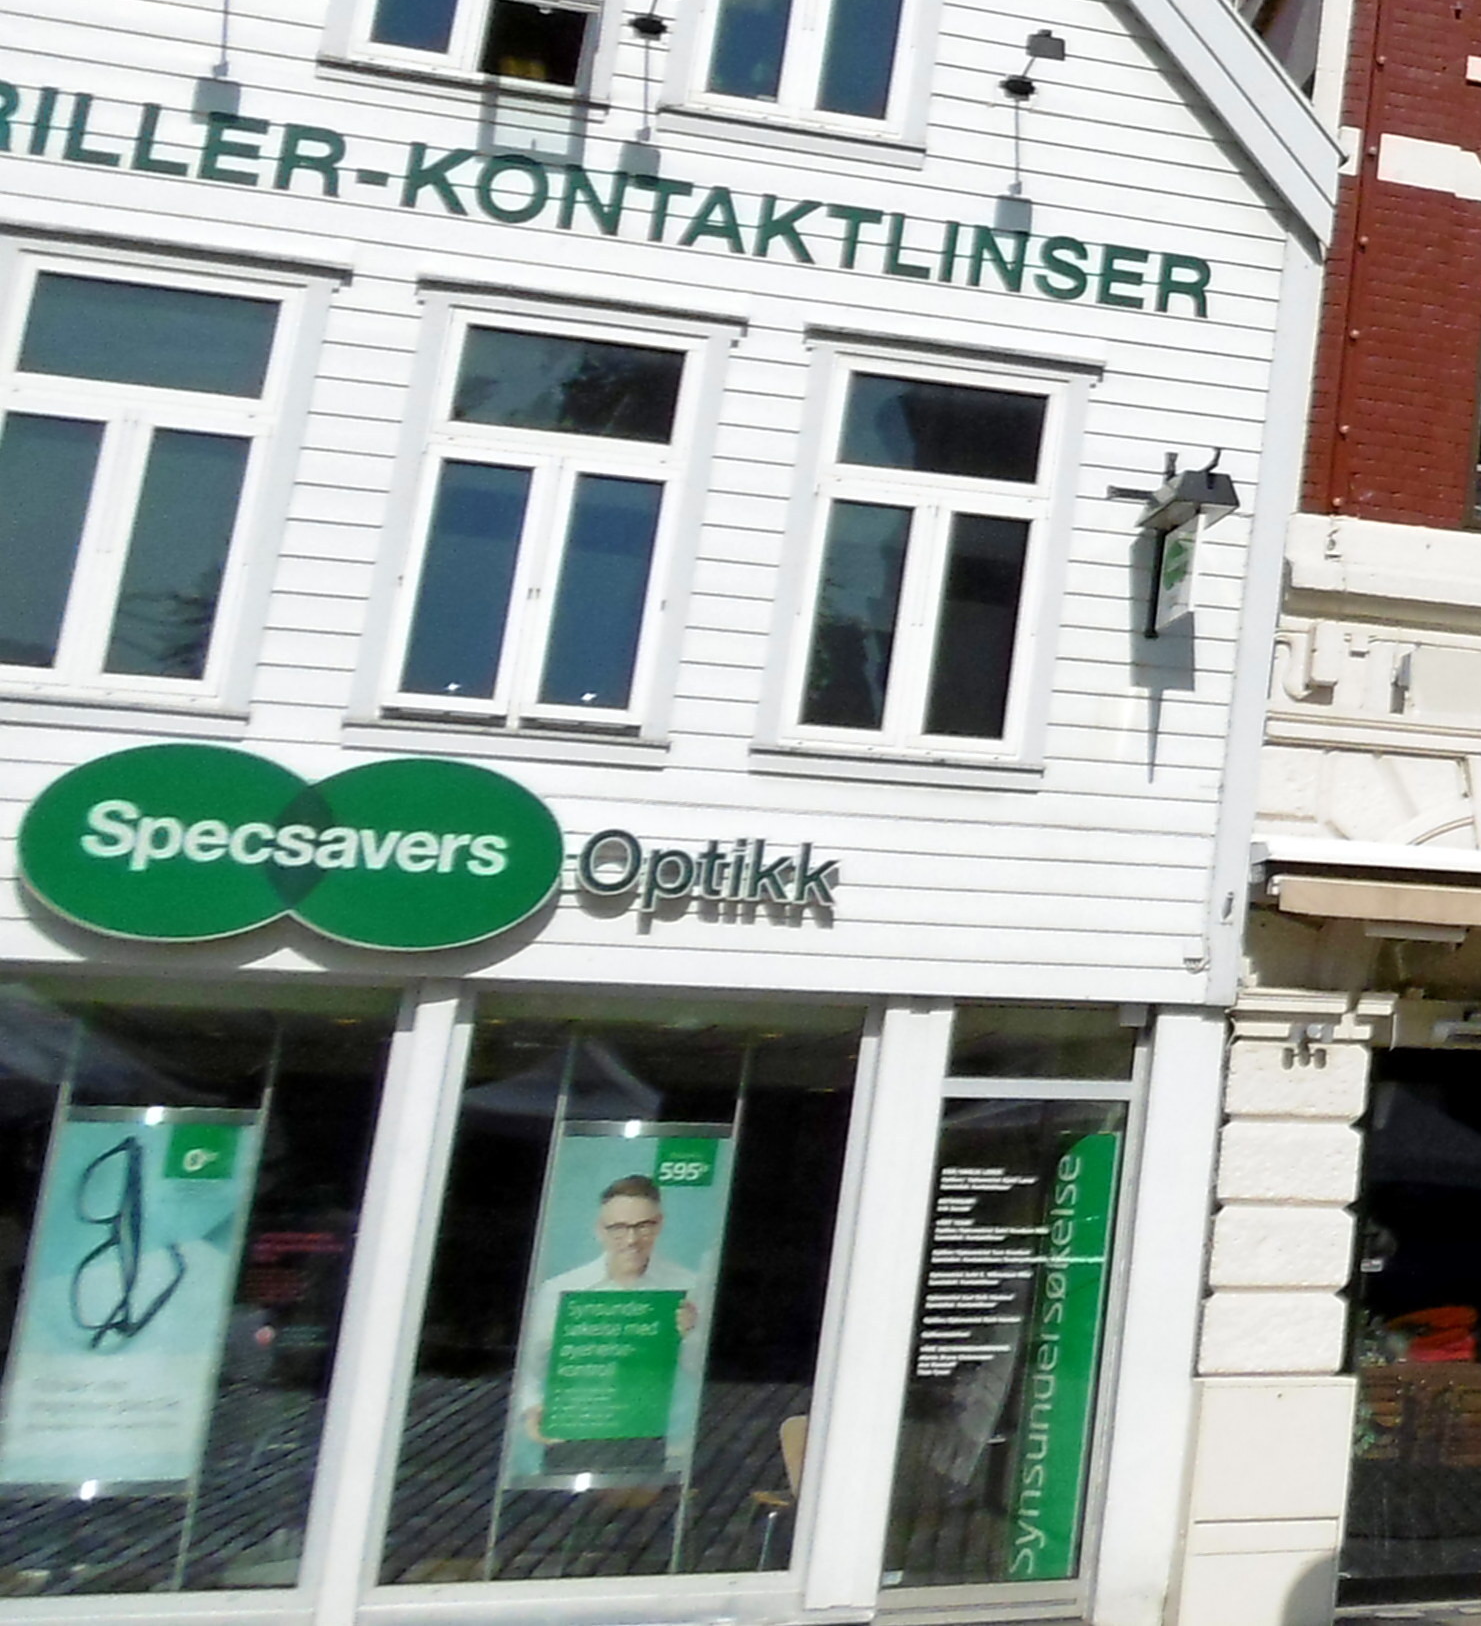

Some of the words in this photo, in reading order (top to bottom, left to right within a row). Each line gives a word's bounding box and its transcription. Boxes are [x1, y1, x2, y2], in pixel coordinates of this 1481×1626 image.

[0, 78, 1214, 319] ILLER-KONTAKTLINSER
[81, 798, 509, 876] Specsavers
[577, 828, 841, 912] Optikk
[1009, 1153, 1083, 1574] Synsundersøkelse
